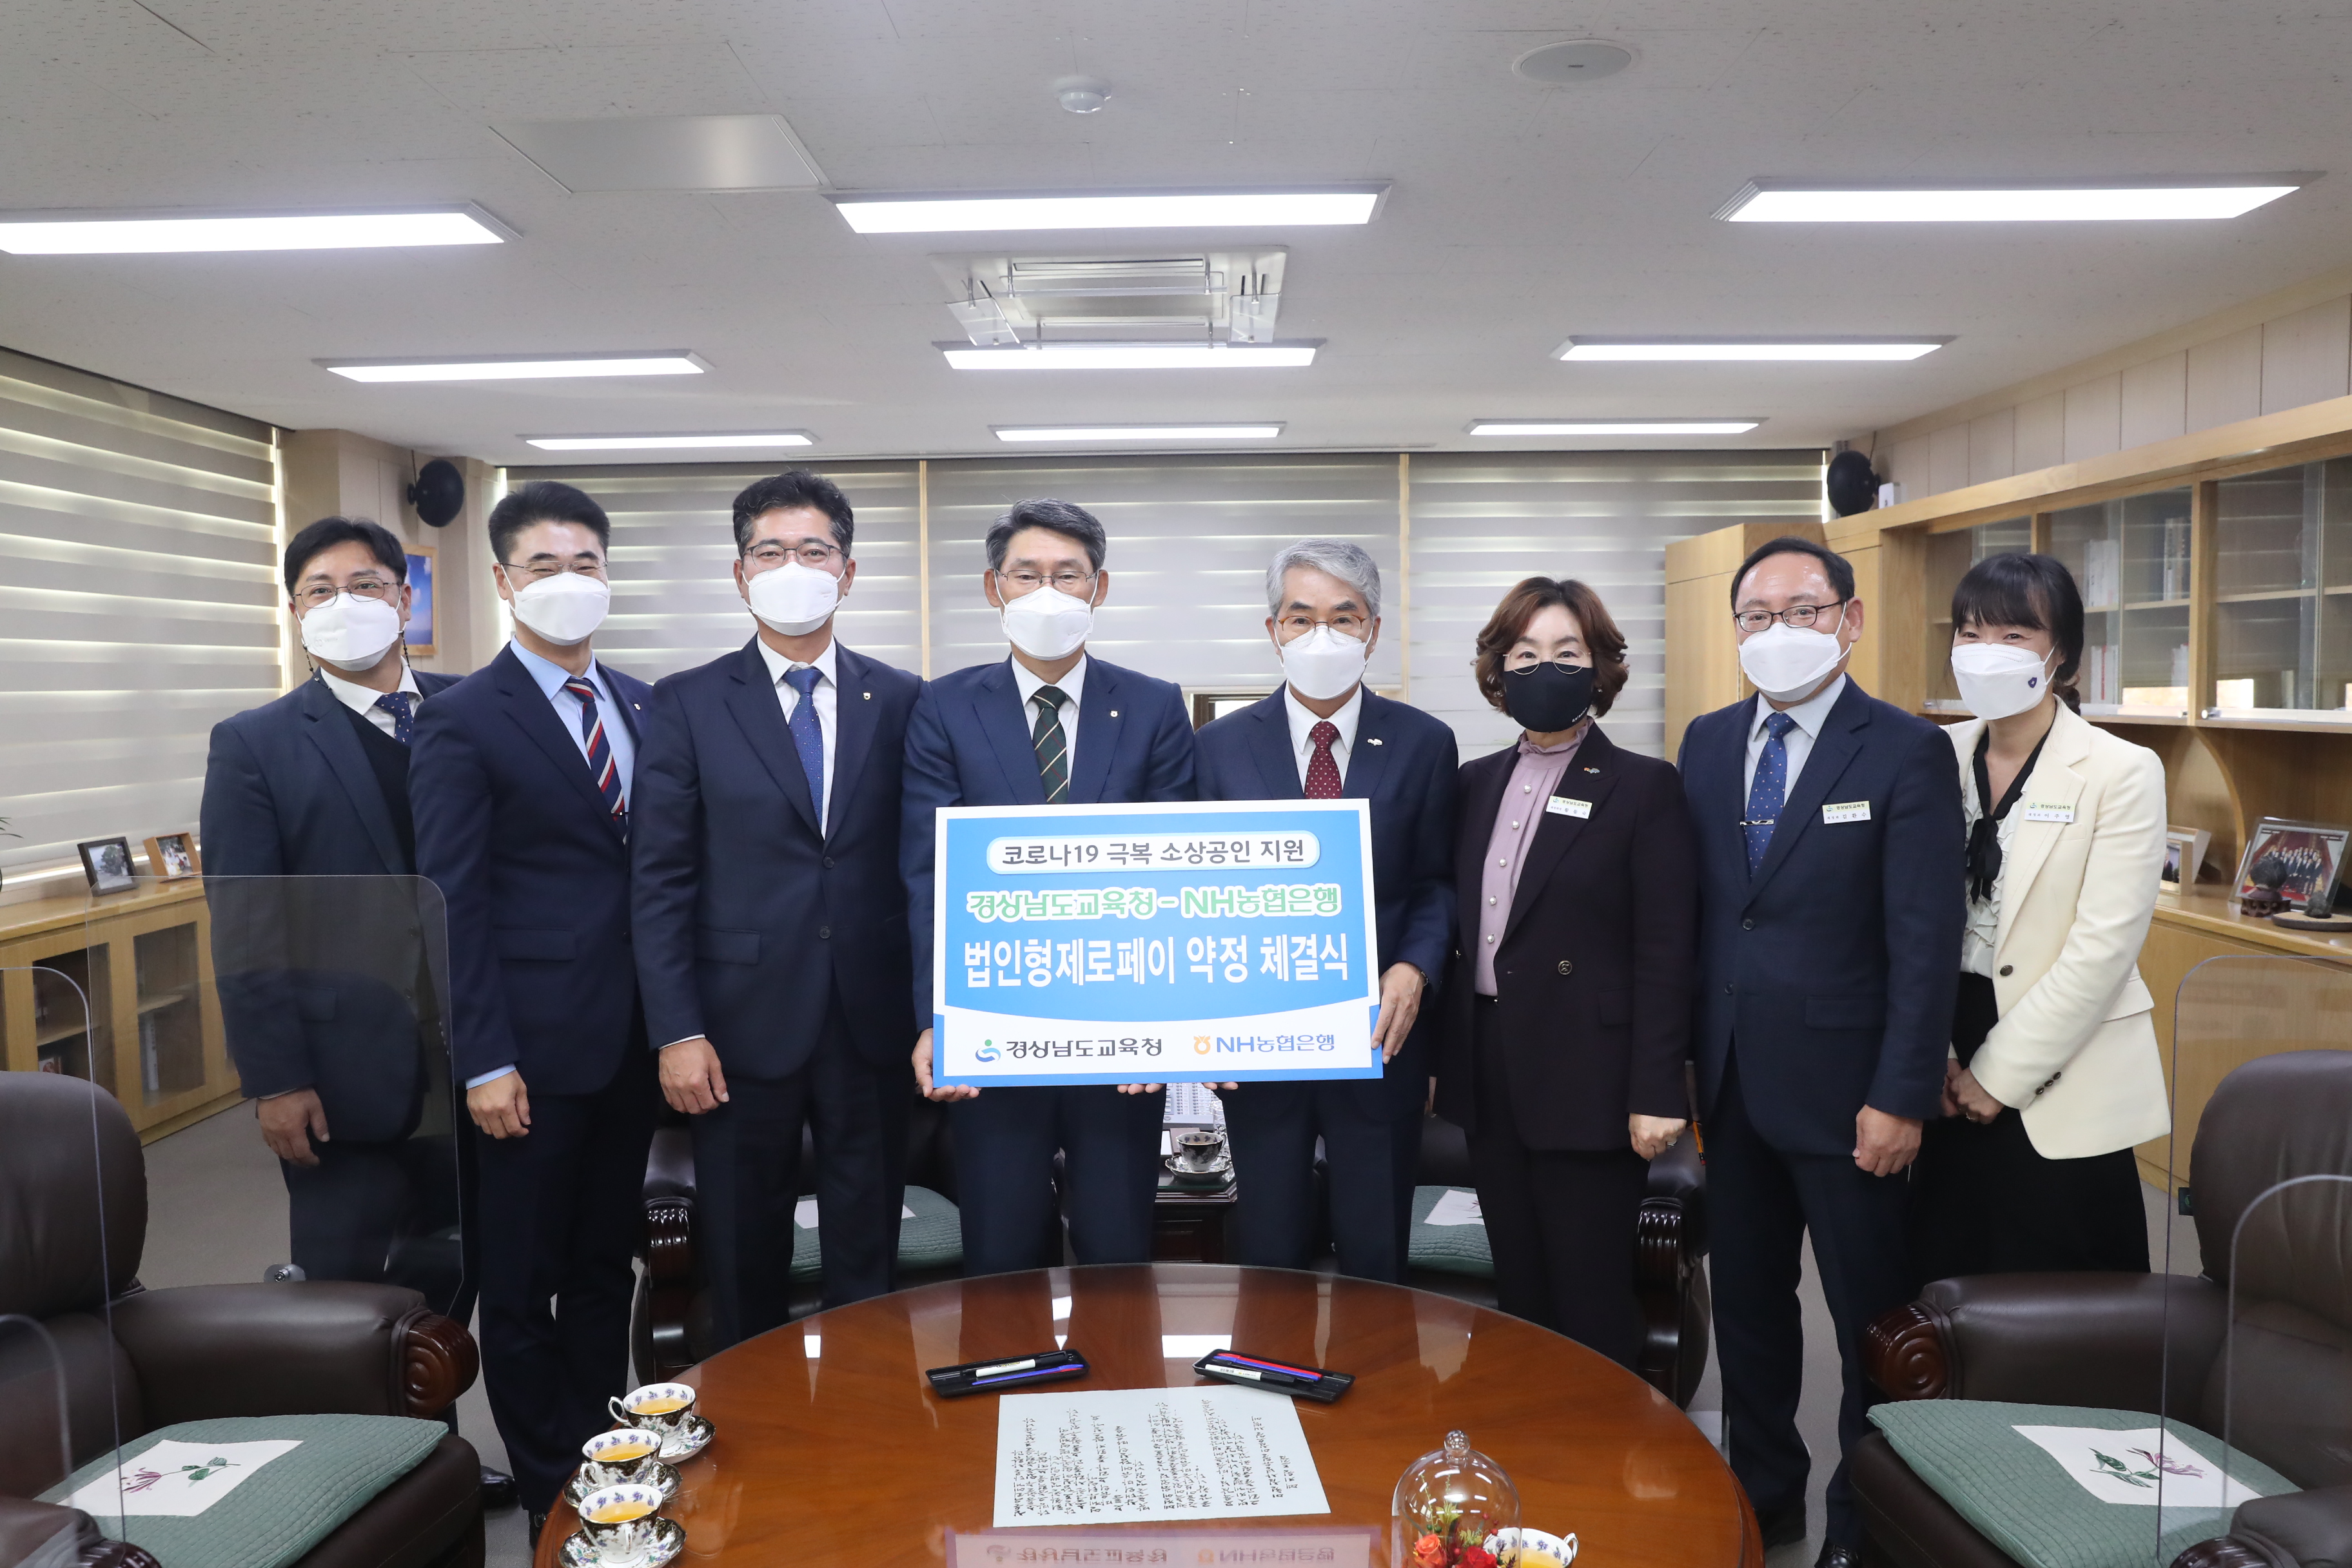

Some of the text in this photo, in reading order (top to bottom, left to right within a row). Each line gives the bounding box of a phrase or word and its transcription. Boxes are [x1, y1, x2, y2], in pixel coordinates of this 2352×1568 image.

[1002, 839, 1304, 867] 코로나19 극복 소상공인 지원
[965, 932, 1348, 988] 법인형제로페이 약정 체결식
[1006, 1037, 1162, 1059] 경상남도교육청
[1216, 1034, 1335, 1054] NH농협은행
